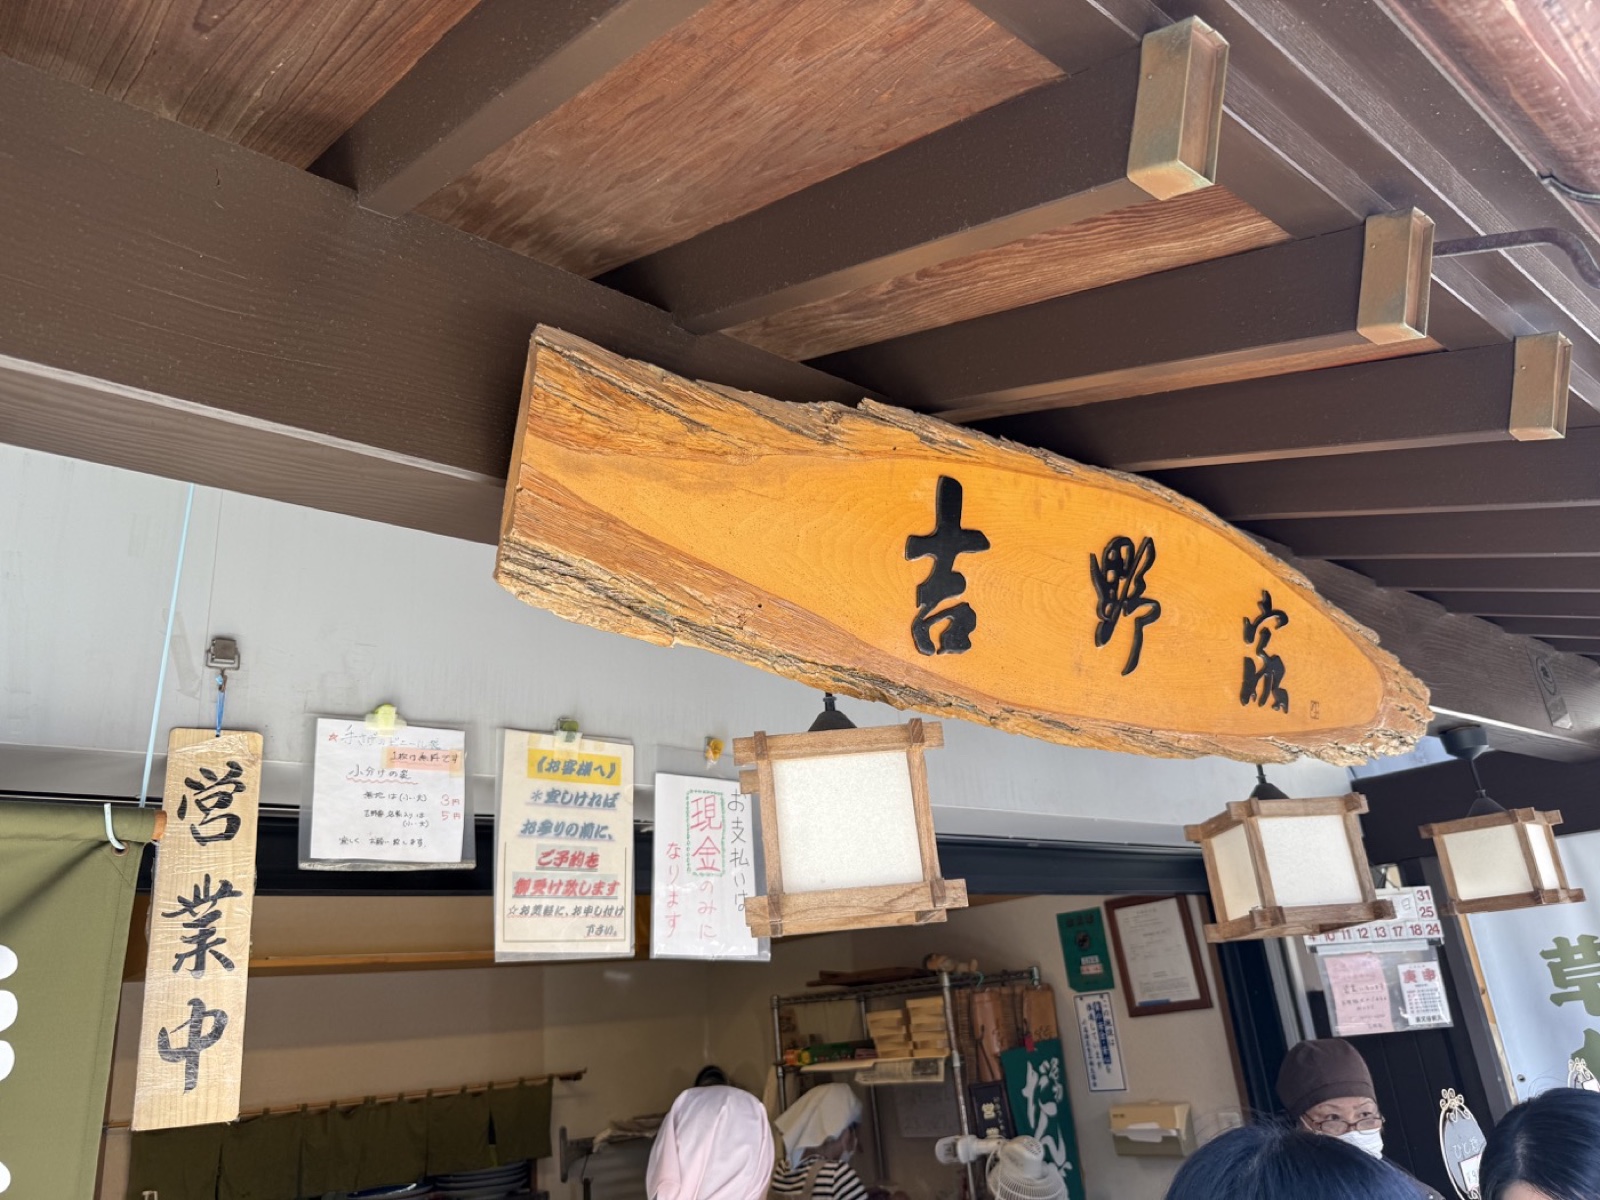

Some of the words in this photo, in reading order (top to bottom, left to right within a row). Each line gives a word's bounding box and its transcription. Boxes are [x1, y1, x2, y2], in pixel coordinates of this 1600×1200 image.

[905, 475, 1290, 714] 吉野家
[348, 763, 412, 780] 小分けの袋
[440, 794, 461, 806] 3円
[441, 810, 461, 821] 5円
[536, 848, 601, 868] ご予約を
[727, 788, 750, 912] お支払いは
[690, 794, 723, 939] 現金のみに
[513, 876, 621, 897] 御受け致します
[665, 841, 682, 939] なります
[1416, 889, 1431, 901] 31
[1419, 905, 1434, 918] 25
[158, 761, 246, 1093] 営業中
[1341, 929, 1352, 940] 11
[1356, 927, 1369, 939] 12
[1374, 926, 1387, 938] 13
[1392, 925, 1403, 937] 17
[1409, 924, 1423, 936] 18
[1426, 923, 1440, 935] 24
